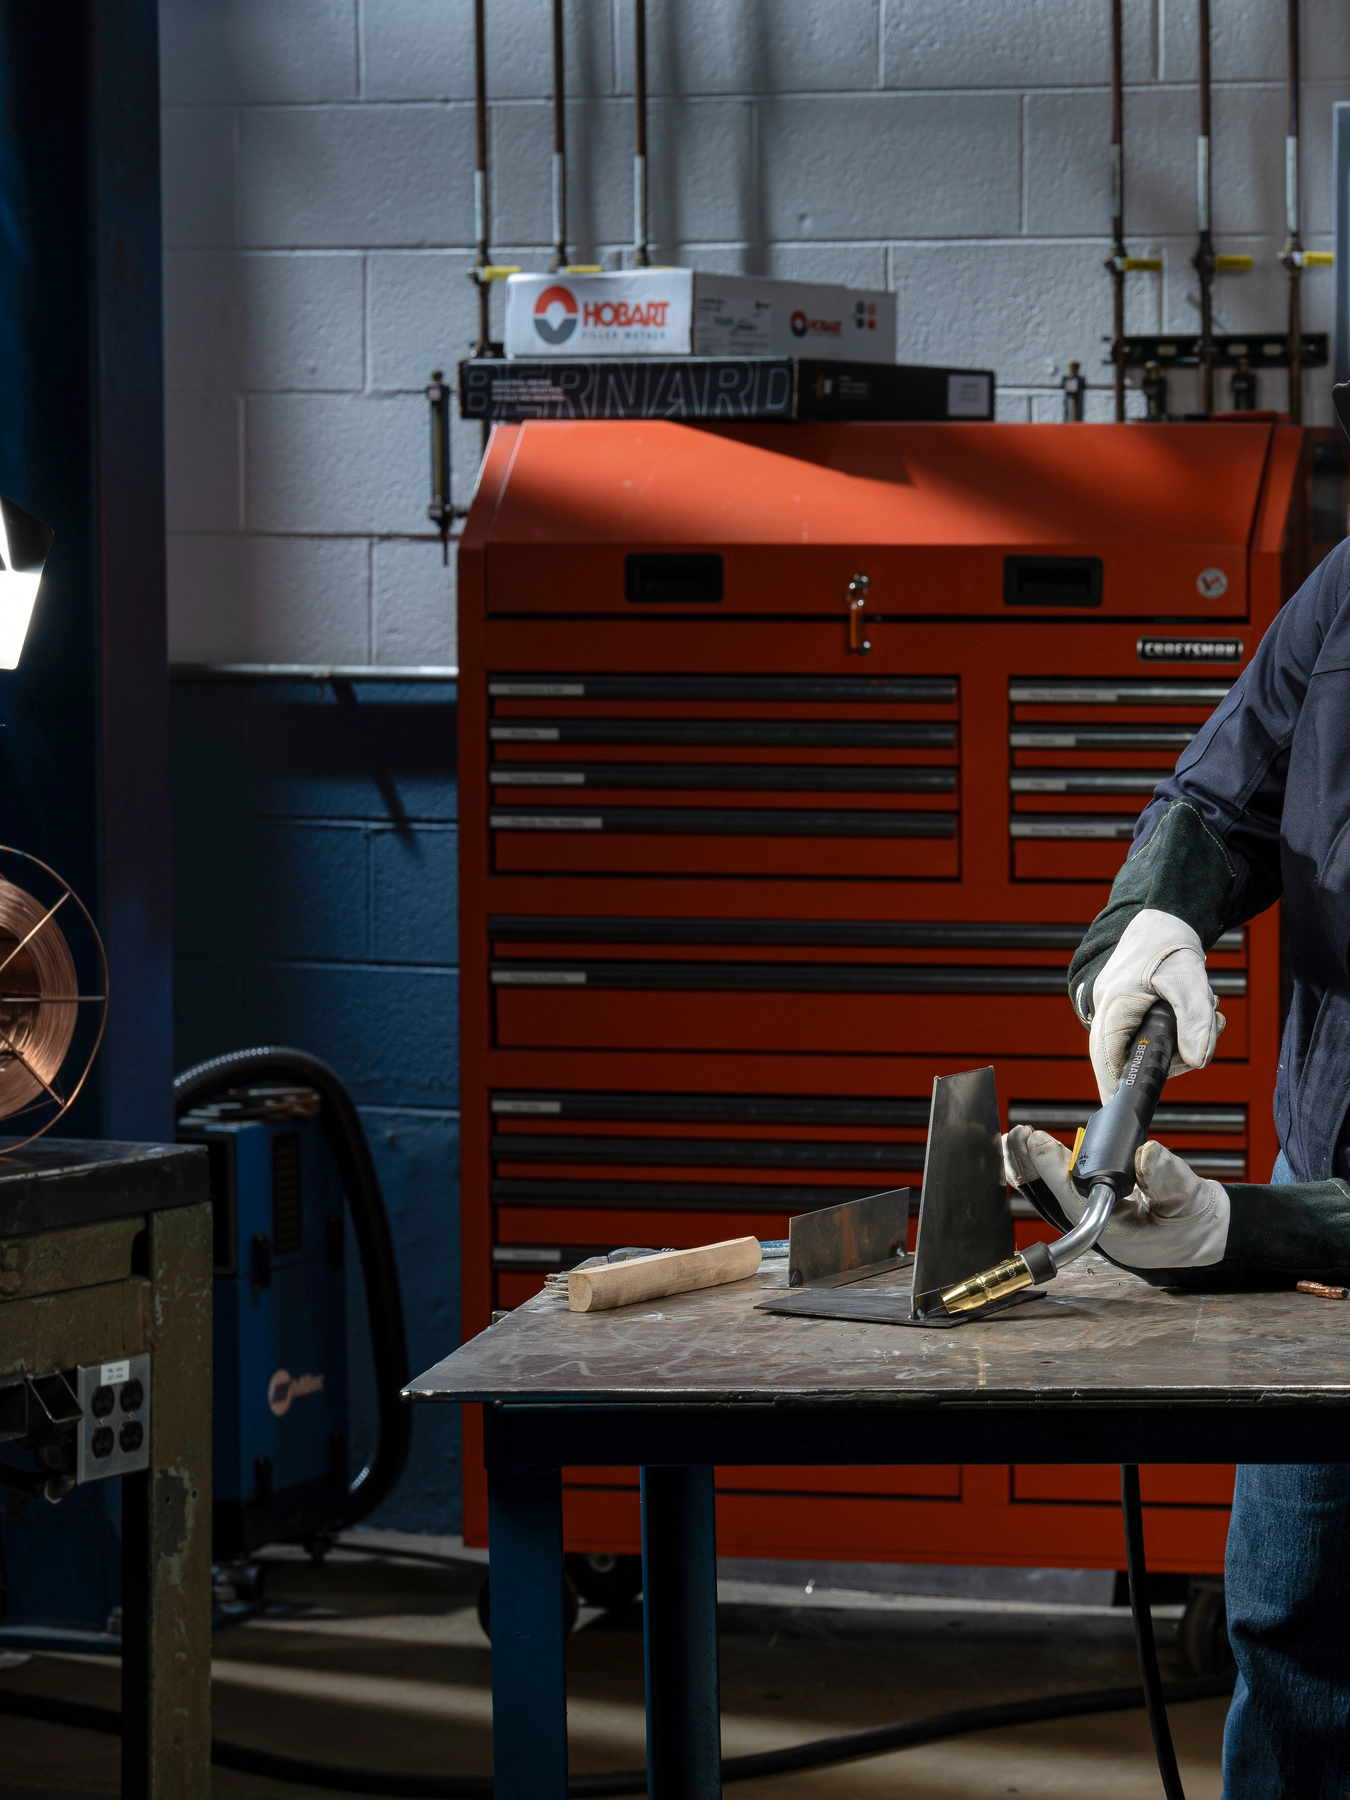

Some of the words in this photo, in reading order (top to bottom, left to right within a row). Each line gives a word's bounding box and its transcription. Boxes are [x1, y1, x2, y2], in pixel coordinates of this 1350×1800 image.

[582, 302, 670, 328] HOBART
[1144, 641, 1237, 657] CRAFTSMAN
[1125, 1044, 1147, 1087] BERNARD
